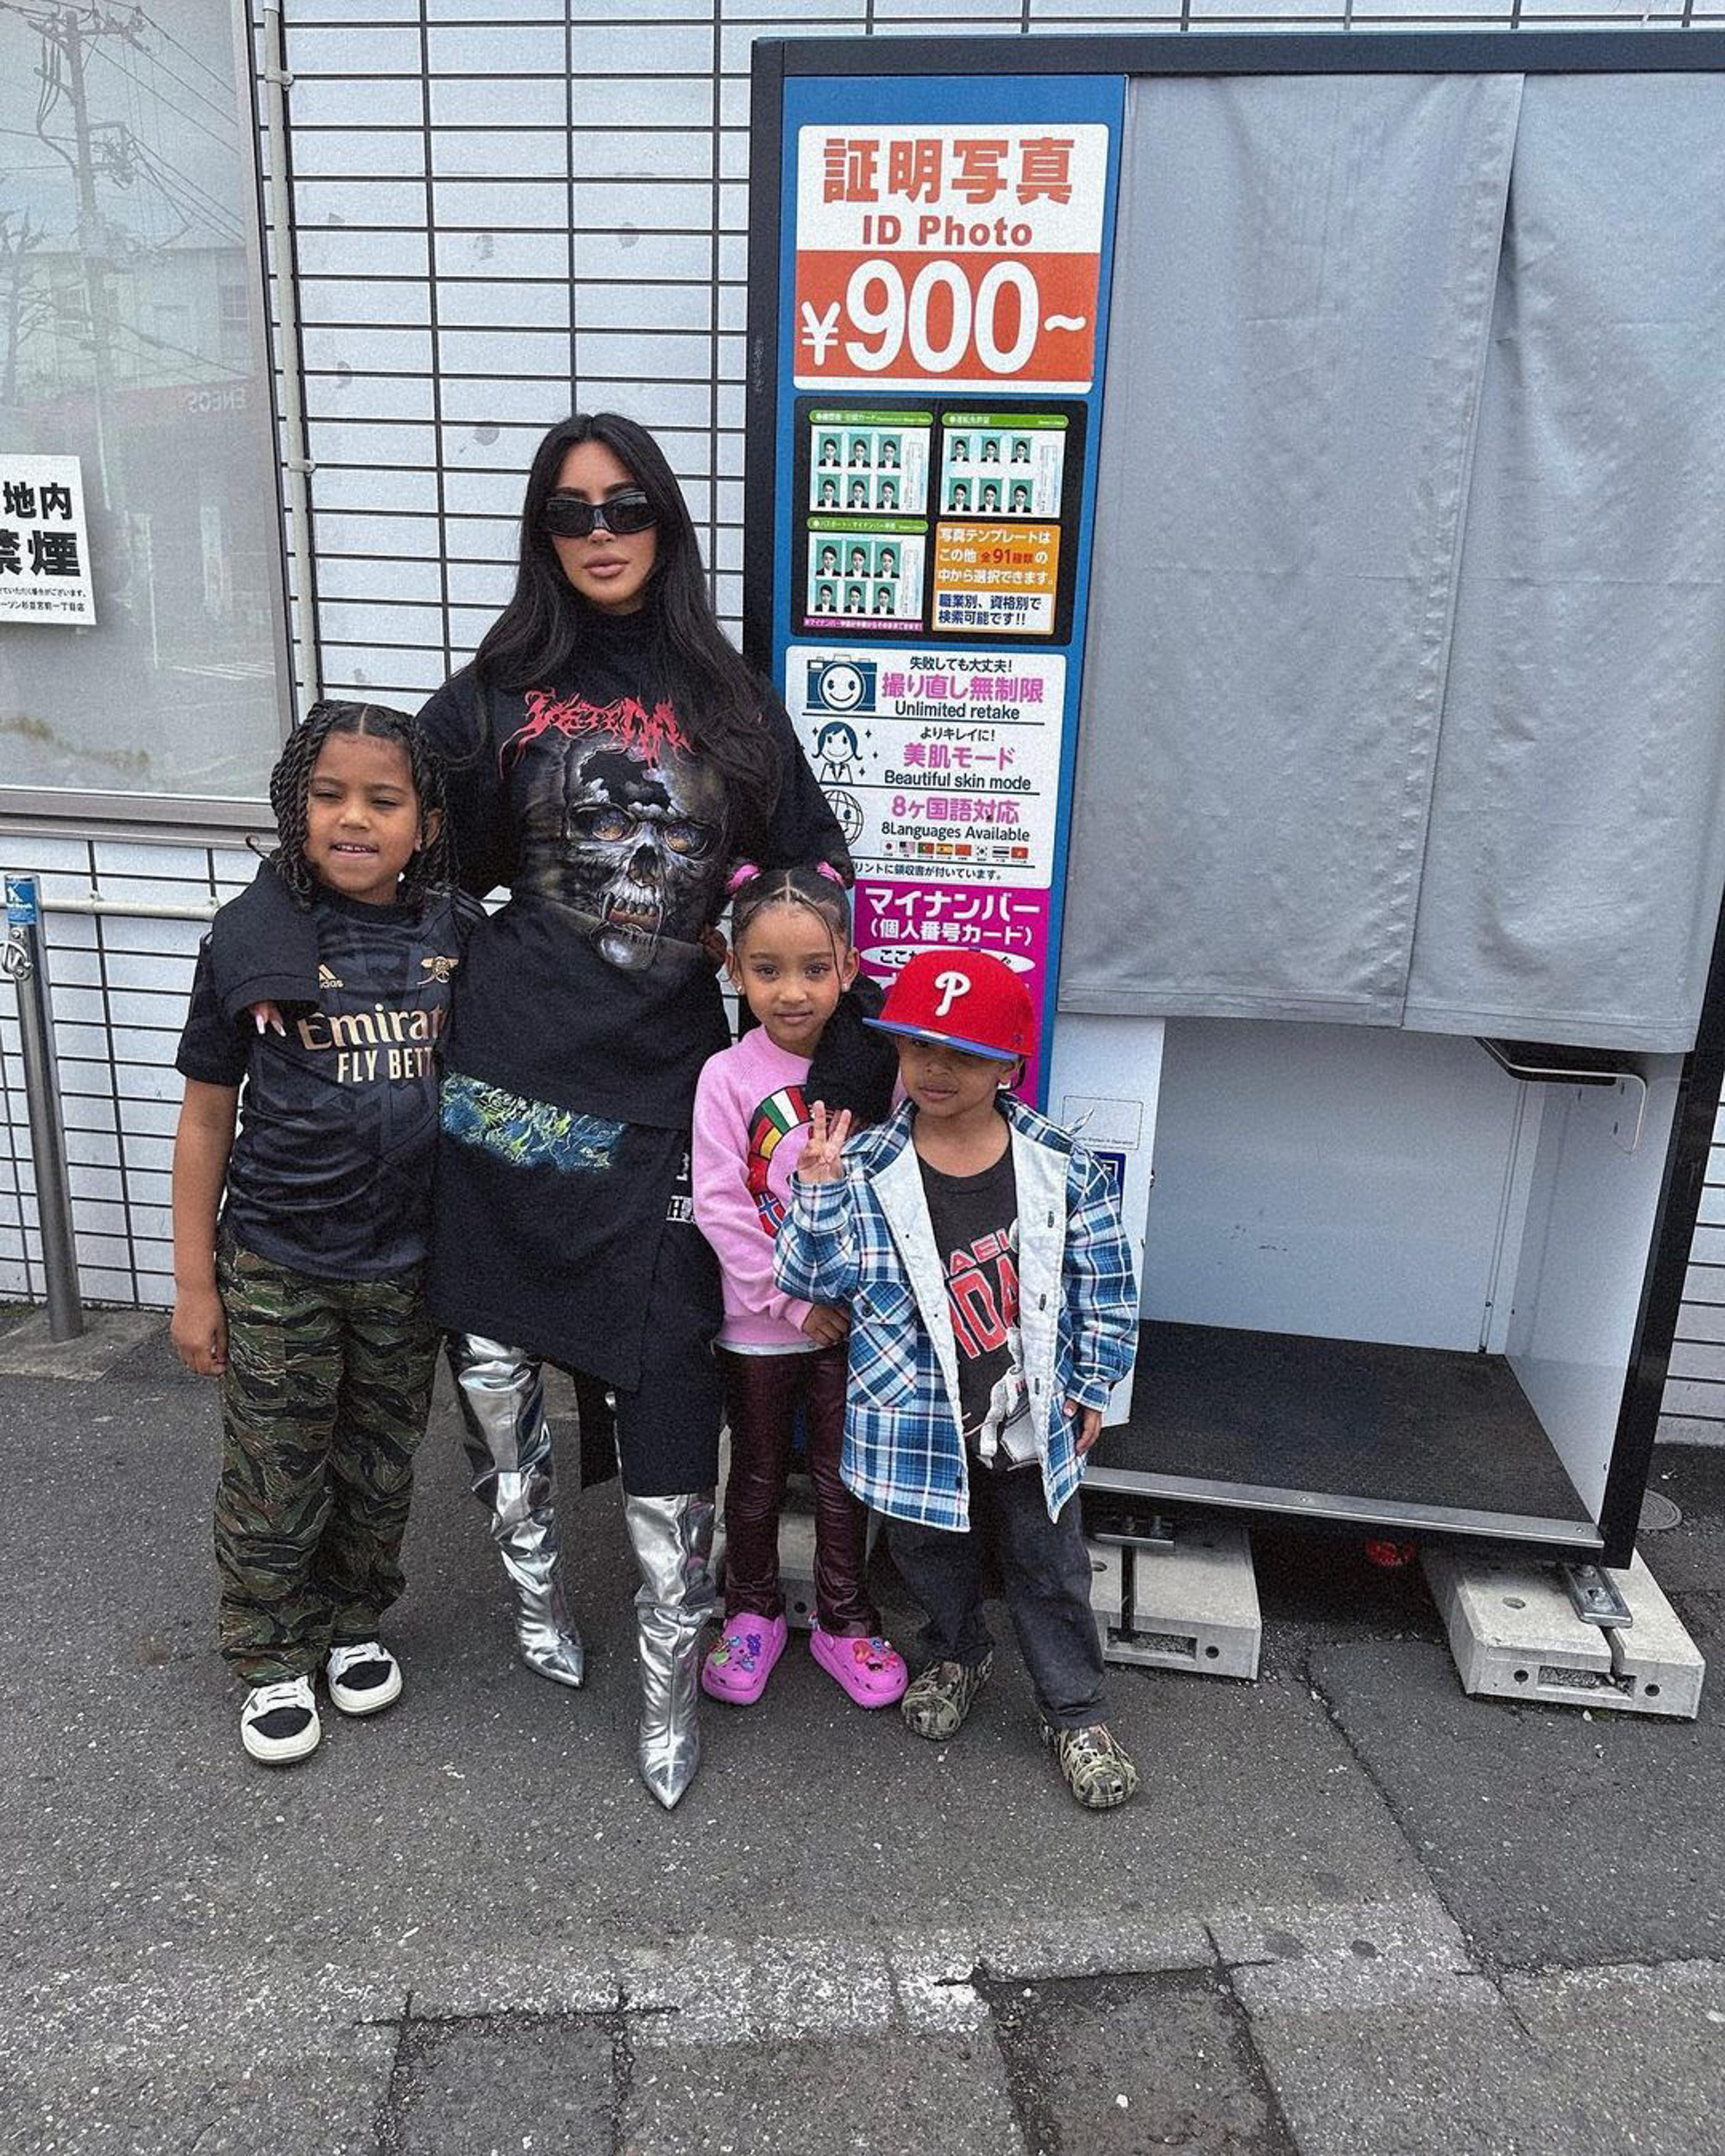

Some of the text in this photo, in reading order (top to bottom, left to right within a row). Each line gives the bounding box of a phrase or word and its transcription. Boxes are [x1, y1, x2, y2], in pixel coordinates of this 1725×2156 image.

[824, 137, 1075, 205] 証明写真
[862, 215, 1032, 246] ID Photo
[3, 481, 72, 520] 地内
[940, 528, 1050, 543] 写真テンプレートは
[938, 569, 1052, 585] 中から選択できます。
[910, 657, 1012, 673] 失敗しても大丈夫!
[881, 673, 1044, 703] 撮り直し無制限
[895, 701, 1019, 719] Unlimited retake
[920, 727, 995, 741] よりキレイに!
[904, 743, 1015, 771] 美肌モード
[885, 770, 1032, 790] Beautiful skin mode
[881, 822, 1030, 842] 8Languages Available
[852, 862, 1001, 881] リントに領収書が付いています。
[865, 887, 1040, 921] マイナンバー
[870, 918, 1032, 946] (個人番号カード)
[935, 971, 971, 1016] P
[297, 1003, 447, 1050] Emirat
[337, 1047, 434, 1083] FLY BETT
